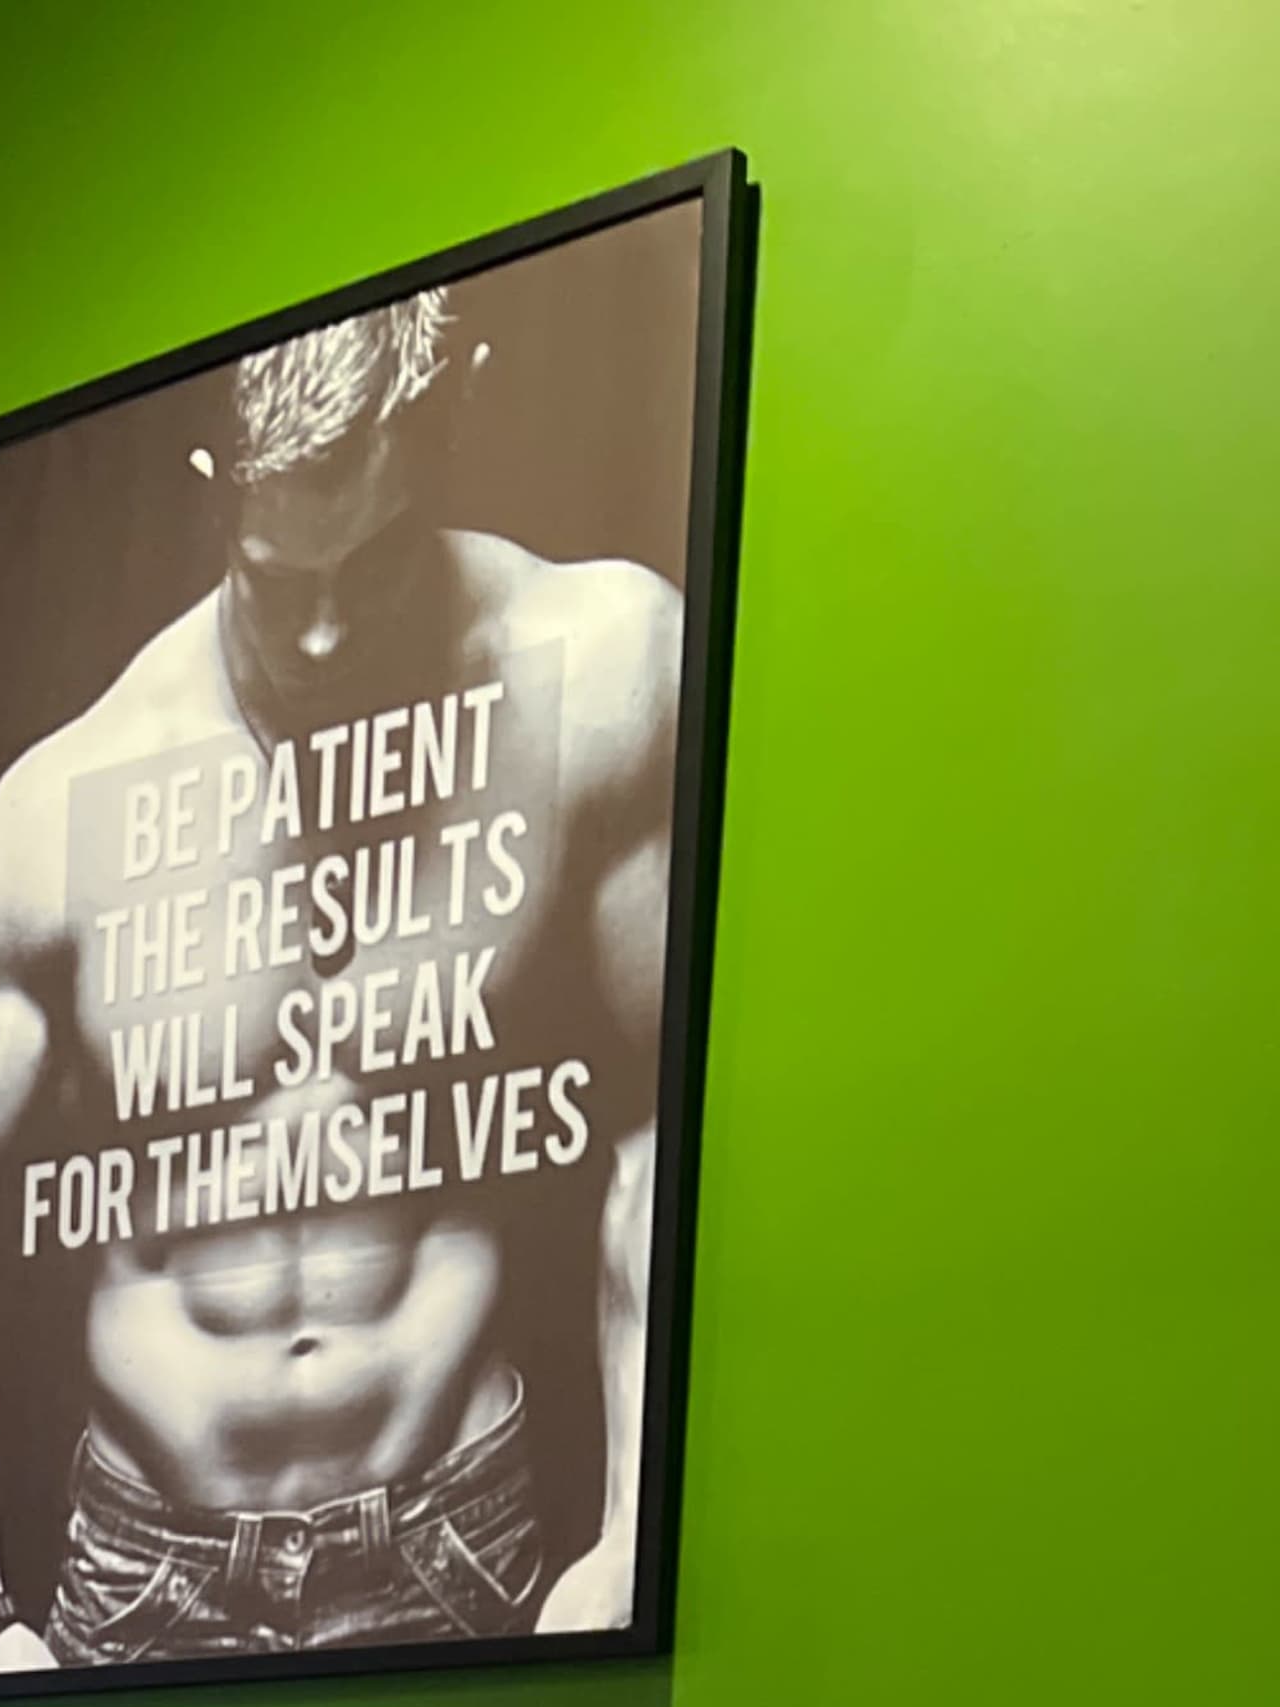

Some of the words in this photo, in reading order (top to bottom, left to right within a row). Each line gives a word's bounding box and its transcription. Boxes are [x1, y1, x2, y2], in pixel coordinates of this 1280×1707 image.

[123, 768, 201, 881] BE
[217, 683, 504, 856] PATIENT
[95, 890, 207, 1004] THE
[225, 811, 527, 978] RESULTS
[110, 1004, 254, 1121] WILL
[274, 947, 496, 1087] SPEAK
[22, 1148, 133, 1256] FOR
[148, 1060, 591, 1236] THEMSELVES
